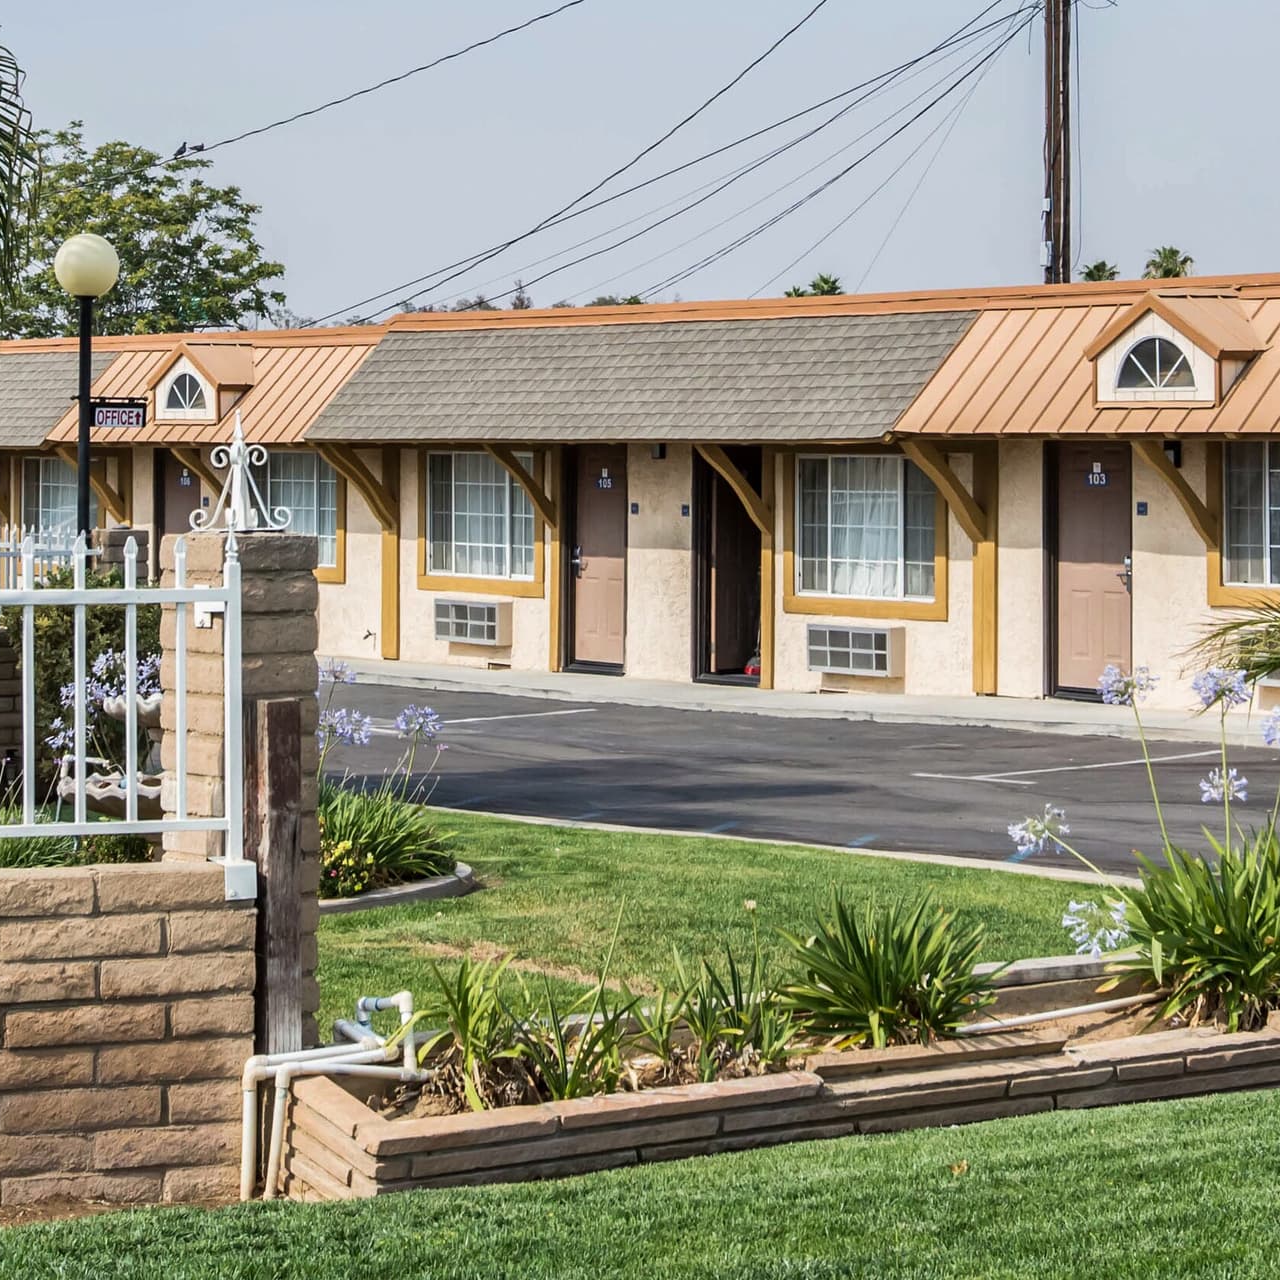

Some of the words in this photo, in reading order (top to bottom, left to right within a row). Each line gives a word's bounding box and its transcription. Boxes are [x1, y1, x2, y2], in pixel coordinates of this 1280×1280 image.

[97, 410, 134, 425] OFFICE
[599, 479, 612, 488] 105
[1088, 474, 1106, 485] 103
